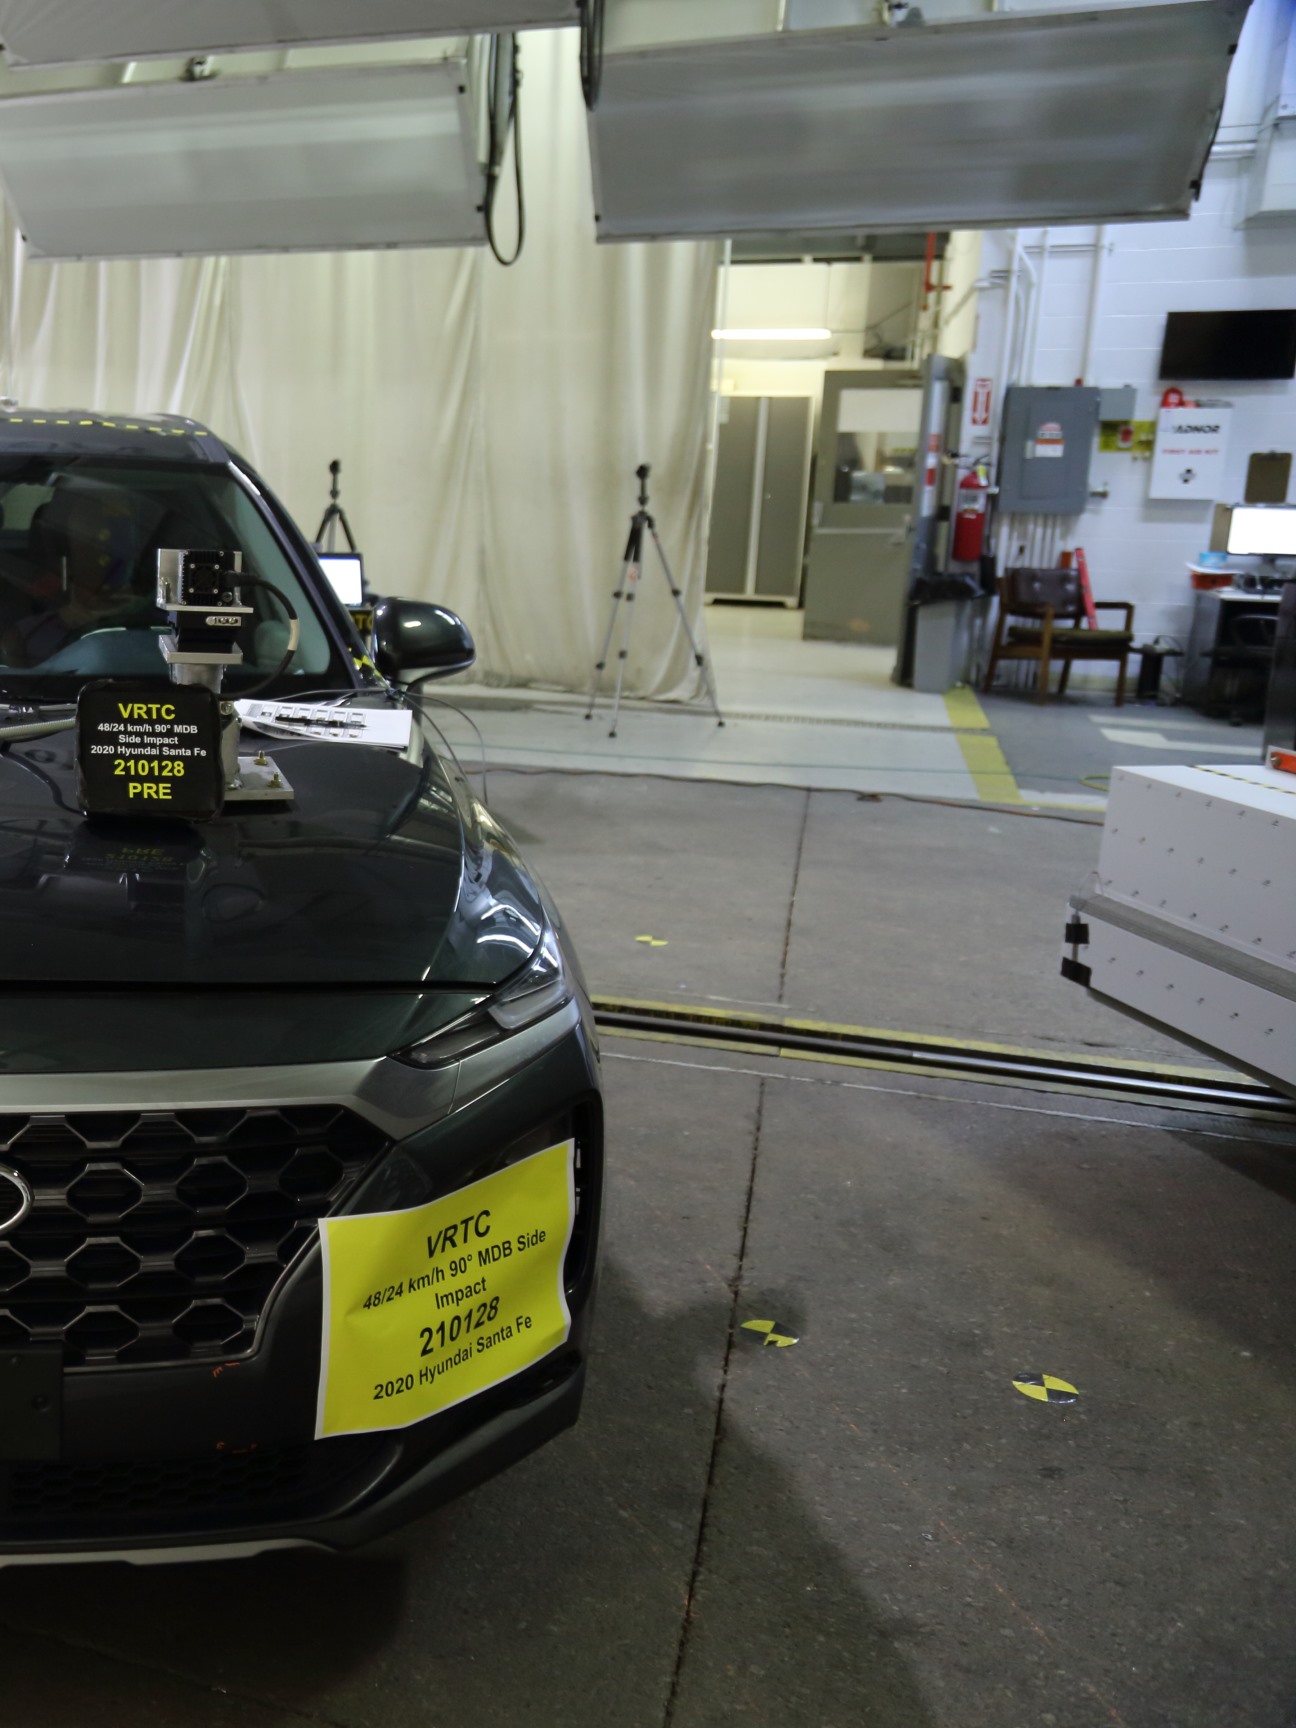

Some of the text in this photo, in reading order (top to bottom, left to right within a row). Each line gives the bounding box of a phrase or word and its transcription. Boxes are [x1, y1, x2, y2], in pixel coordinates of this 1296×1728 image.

[118, 703, 176, 720] VRTC
[97, 723, 198, 734] 48/24 km/h 90° MDB
[118, 734, 179, 746] Side Impact
[91, 745, 206, 757] 2020 Hyundai Santa Fe
[113, 760, 185, 776] 210128
[128, 783, 172, 799] PRE
[426, 1209, 491, 1258] VRTC
[362, 1228, 546, 1311] 48/24 km/h 90° MDB Side
[435, 1277, 487, 1310] Impact
[419, 1296, 500, 1358] 210128
[373, 1314, 532, 1400] 2020 Hyundai Santa Fe
